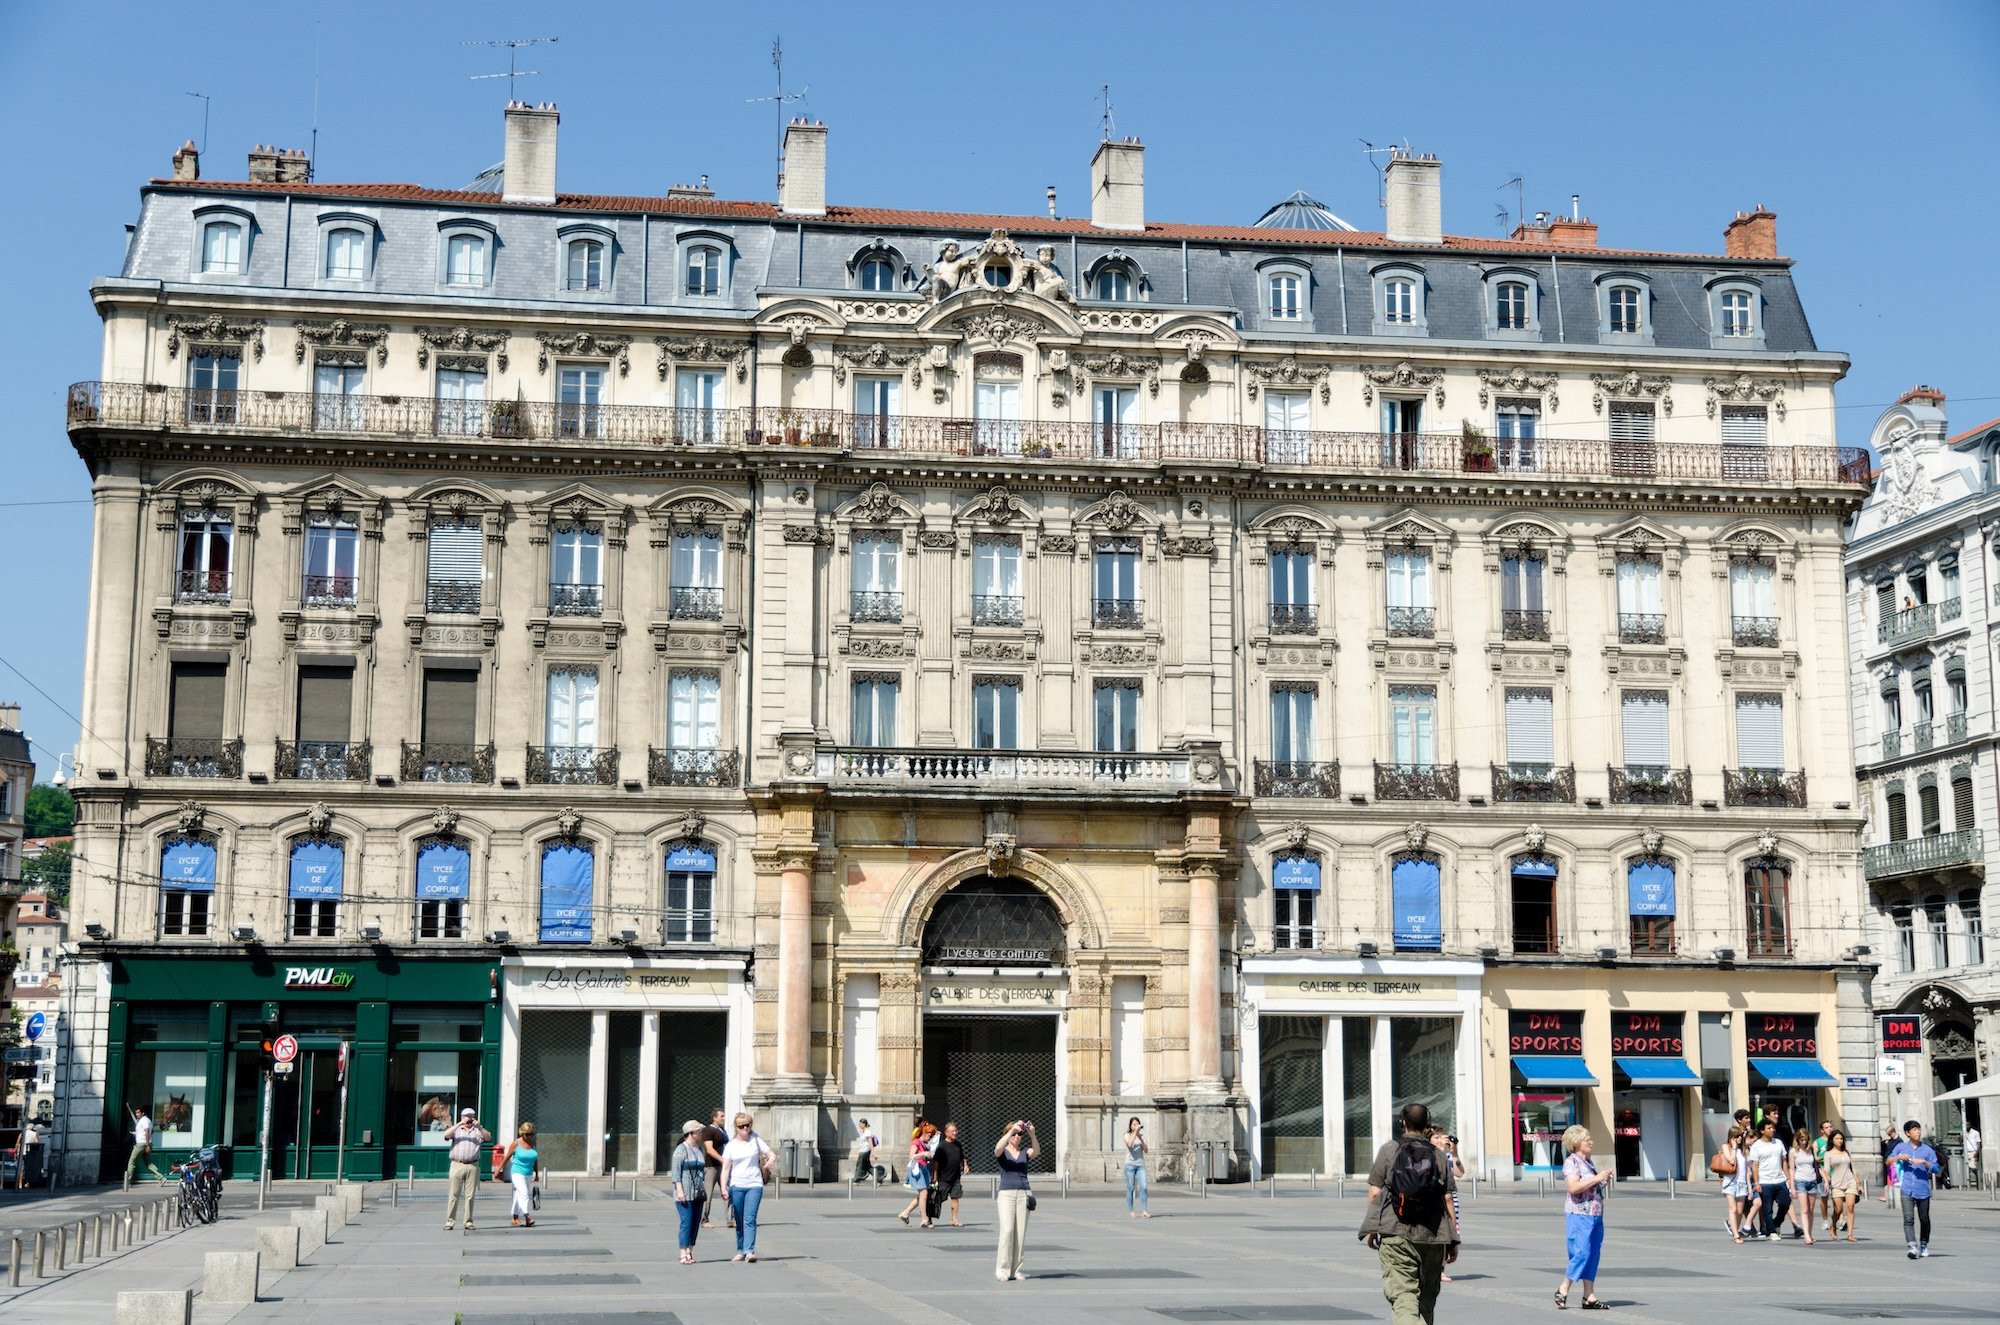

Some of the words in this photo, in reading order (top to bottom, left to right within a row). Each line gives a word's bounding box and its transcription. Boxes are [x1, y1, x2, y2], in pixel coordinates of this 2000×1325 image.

[674, 858, 707, 866] COIFFURE
[984, 949, 997, 958] de
[285, 968, 334, 984] PMU
[538, 969, 569, 990] La
[574, 969, 622, 990] Galerie
[640, 976, 690, 987] TERREAUX
[930, 987, 973, 999] GALERIE
[980, 988, 1000, 999] DES
[1006, 988, 1055, 1000] TERREAUX
[1299, 981, 1341, 993] GALERIE
[1348, 982, 1367, 993] DES
[1373, 982, 1421, 994] TERREAUX
[1530, 1014, 1561, 1030] DM
[1630, 1016, 1661, 1031] DM
[1764, 1016, 1795, 1032] DM
[1888, 1022, 1913, 1034] DM
[1511, 1036, 1582, 1050] SPORTS
[1613, 1037, 1682, 1052] SPORTS
[1748, 1038, 1816, 1053] SPORTS
[1883, 1040, 1921, 1048] SPORTS
